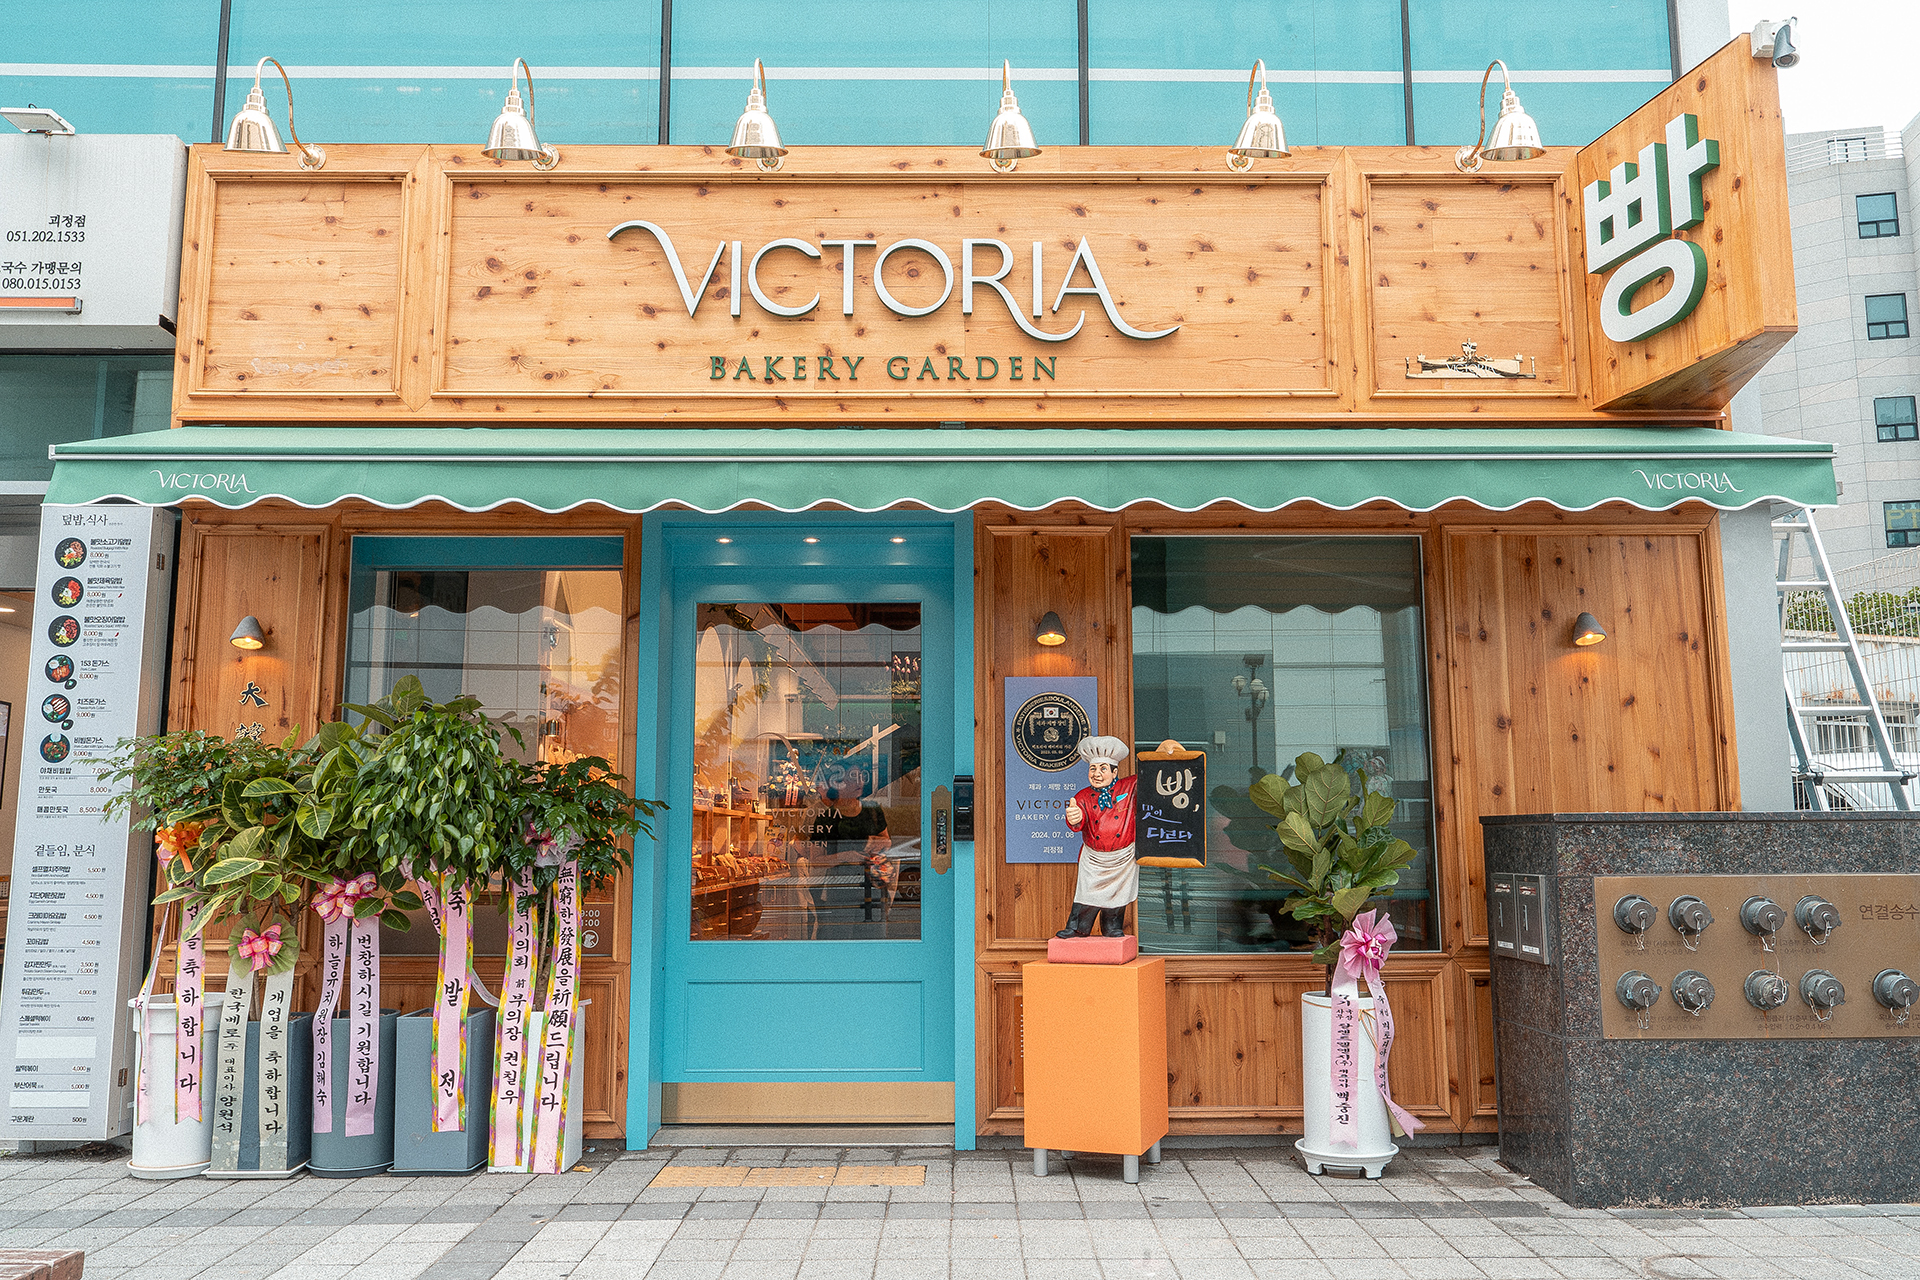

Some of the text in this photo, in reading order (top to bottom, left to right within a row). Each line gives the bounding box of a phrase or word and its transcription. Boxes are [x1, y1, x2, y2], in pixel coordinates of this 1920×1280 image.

[49, 215, 86, 228] 괴정점
[1584, 113, 1720, 342] 빵
[6, 230, 85, 243] 051.202.1533
[0, 261, 82, 275] 국수 가맹문의
[2, 278, 81, 290] 080.015.0153
[606, 219, 1182, 343] VICTORIA
[709, 355, 1060, 381] BAKERY GARDEN
[150, 469, 257, 494] VICTORIA
[1632, 469, 1745, 494] VICTORIA
[1015, 813, 1050, 821] BAKERY
[1031, 831, 1050, 839] 2024.
[34, 844, 95, 857] 곁들임, 분식
[354, 932, 376, 1107] 번창하시길 기원합니다
[504, 991, 527, 1042] 부의장
[264, 989, 285, 1135] 개업을 축하합니다
[315, 1050, 328, 1107] 김해숙
[500, 1051, 519, 1106] 권칠우
